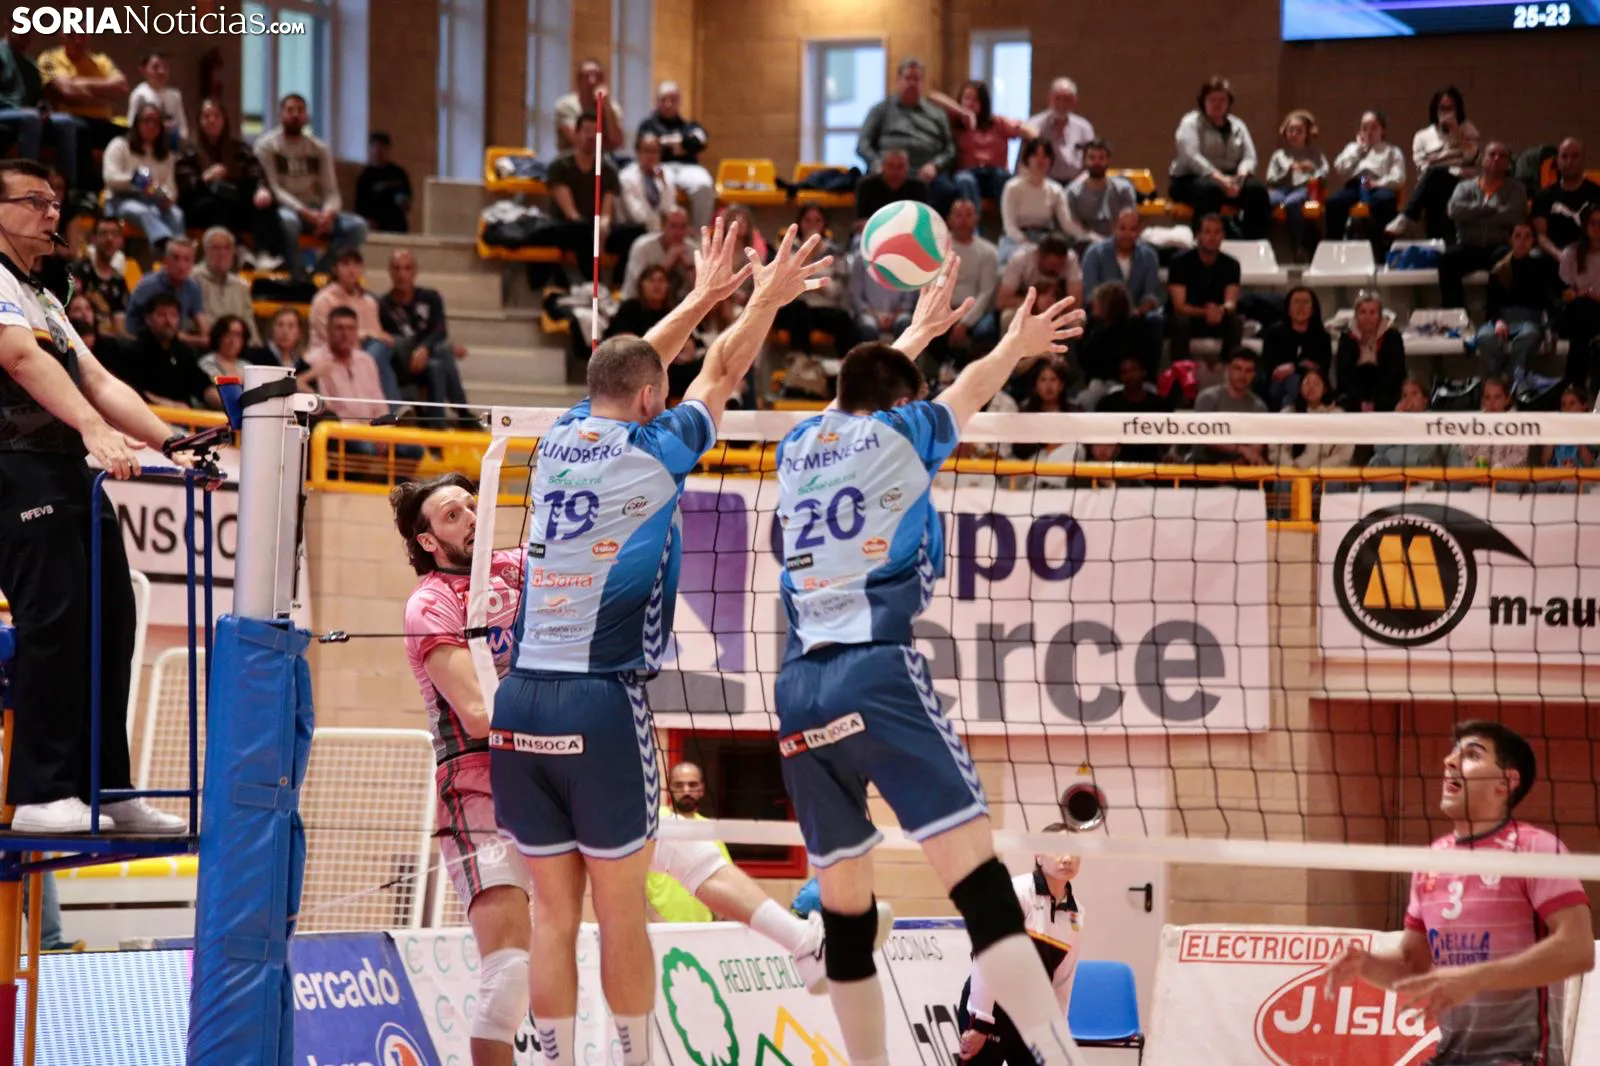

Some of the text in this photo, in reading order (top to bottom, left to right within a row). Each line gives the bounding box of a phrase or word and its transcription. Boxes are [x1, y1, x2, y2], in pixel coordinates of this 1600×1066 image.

[1122, 418, 1231, 436] rfevb.com
[1425, 418, 1541, 437] rfevb.com
[543, 441, 622, 463] LINDBERG
[20, 504, 54, 522] RFEVB
[544, 490, 600, 540] 19
[794, 486, 865, 550] 20
[1489, 595, 1600, 628] m-au
[516, 738, 579, 751] INSOCA
[808, 719, 859, 744] INOCA
[1441, 881, 1464, 920] 3
[292, 957, 400, 1010] ercado
[719, 959, 752, 993] RED
[746, 957, 772, 991] DE
[1272, 986, 1427, 1036] J. Isla
